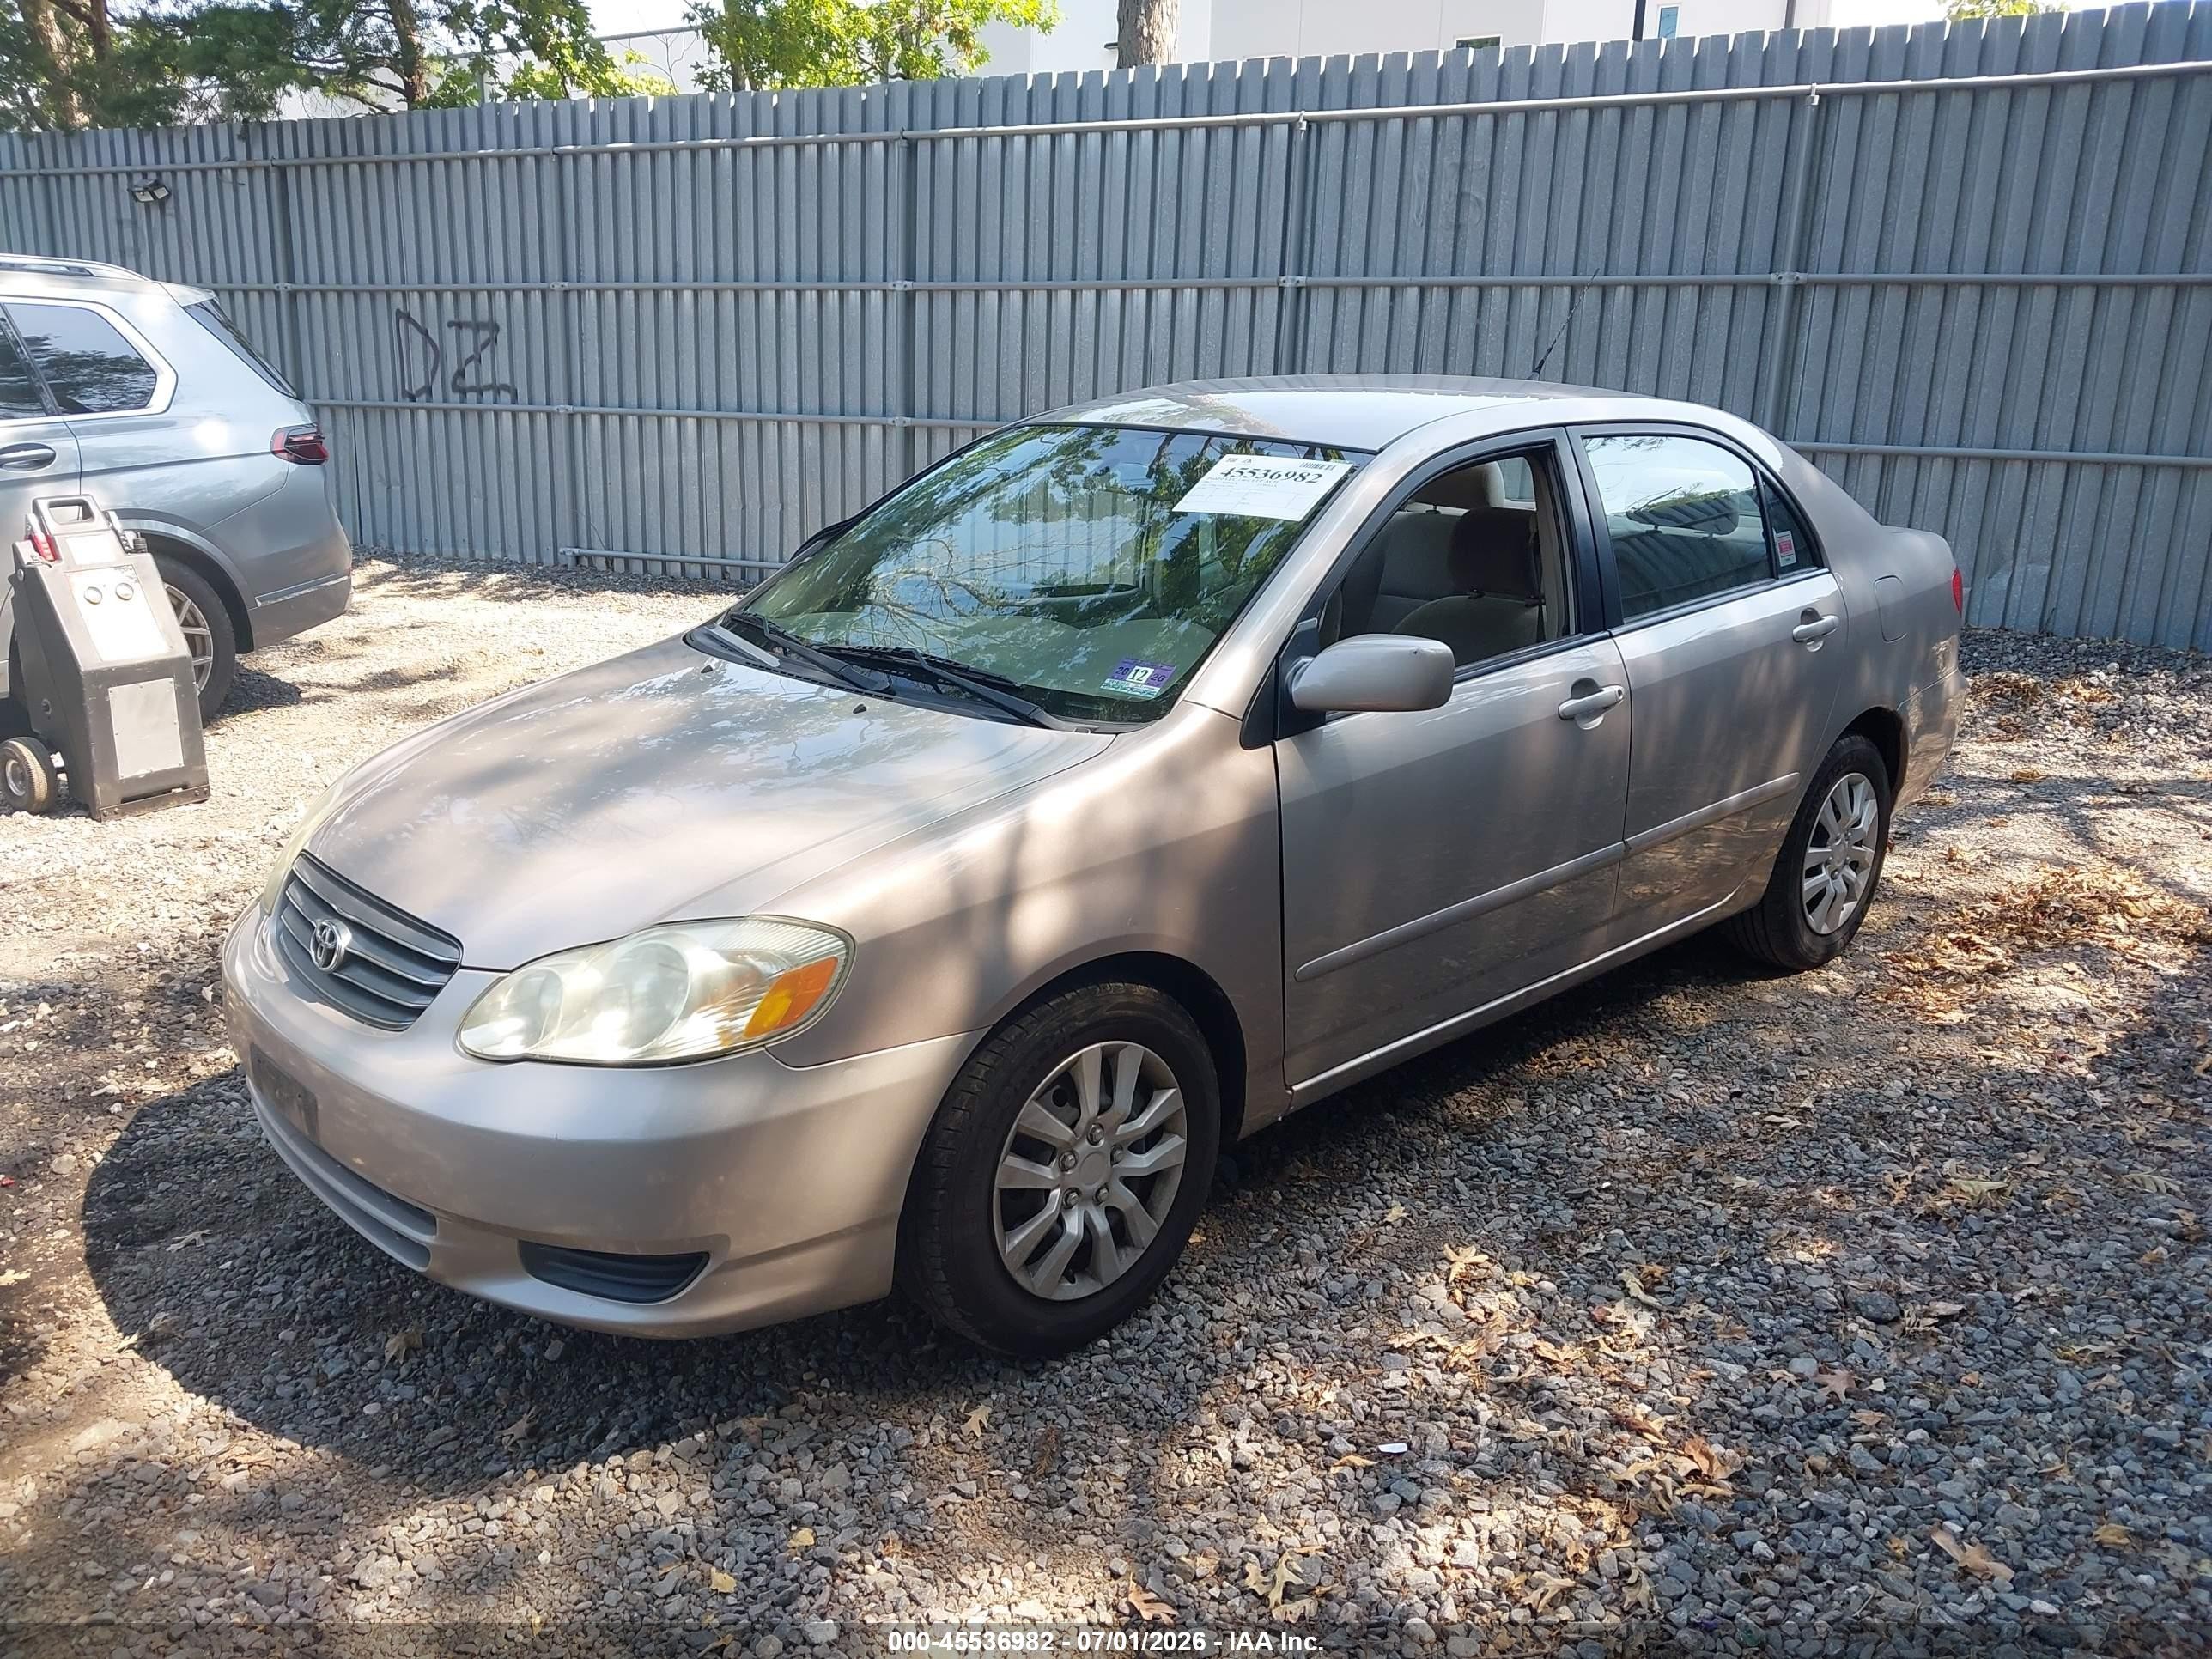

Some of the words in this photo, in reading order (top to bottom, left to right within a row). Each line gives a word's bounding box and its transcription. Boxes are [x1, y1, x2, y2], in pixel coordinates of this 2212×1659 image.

[395, 308, 518, 404] DZ
[1220, 466, 1322, 483] 45536982
[1115, 666, 1130, 675] 20
[1130, 668, 1148, 681] 12
[1150, 673, 1166, 683] 26
